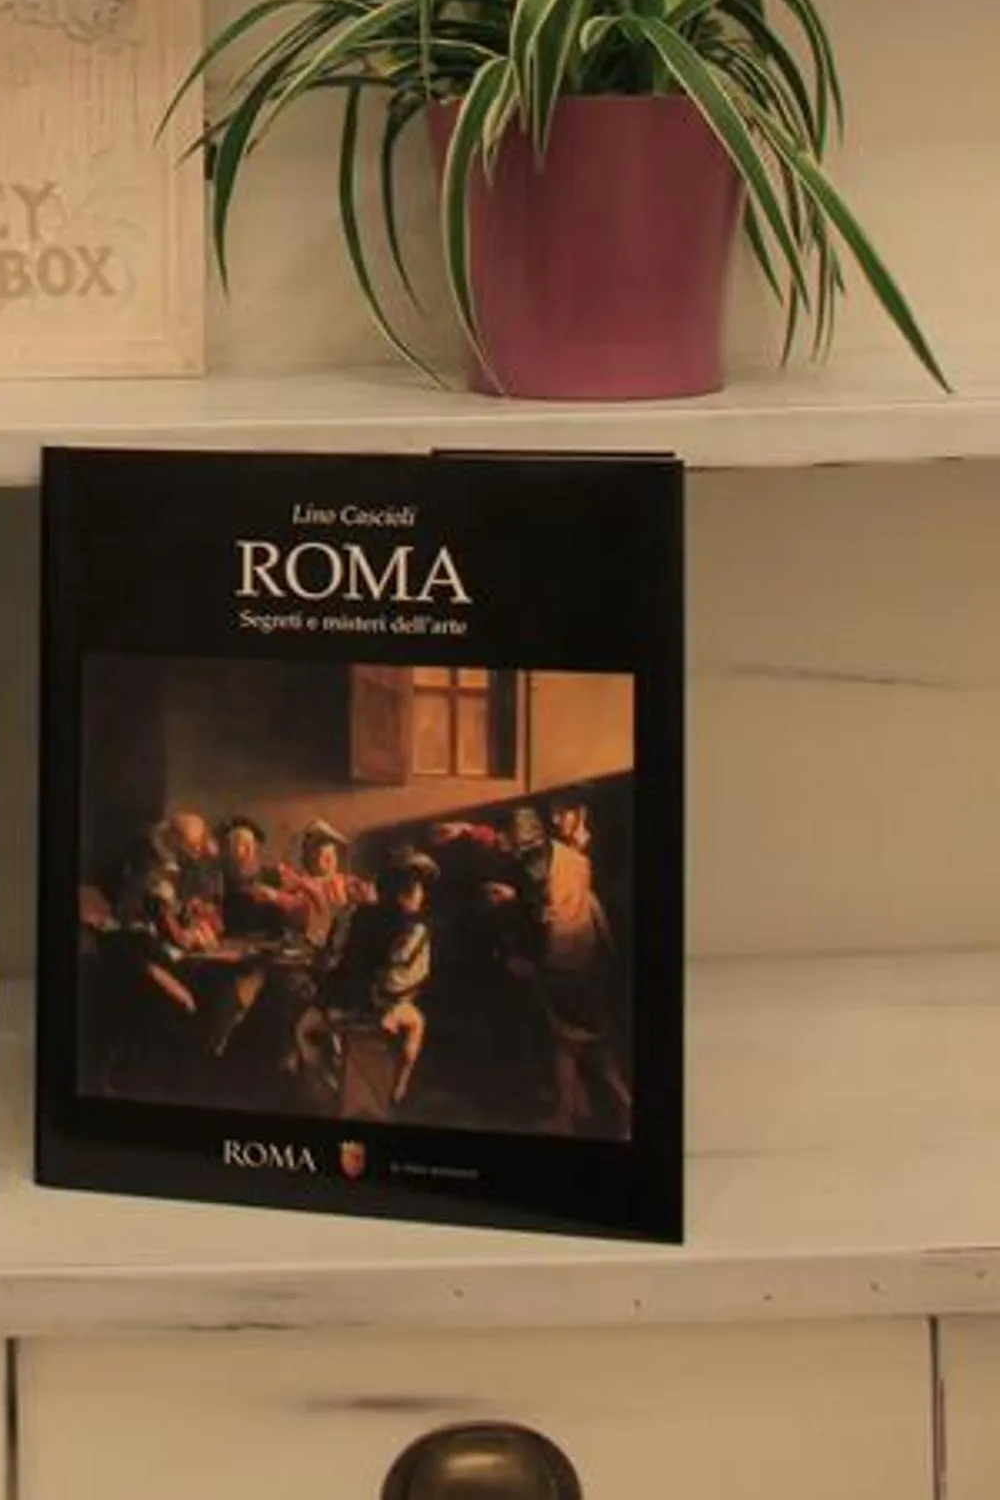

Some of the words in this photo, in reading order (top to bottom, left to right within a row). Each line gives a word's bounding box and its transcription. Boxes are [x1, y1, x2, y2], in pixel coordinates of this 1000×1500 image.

[292, 504, 336, 526] Lino
[235, 541, 473, 605] ROMA
[306, 617, 317, 629] e
[322, 615, 387, 632] misteri
[223, 1140, 317, 1173] ROMA
